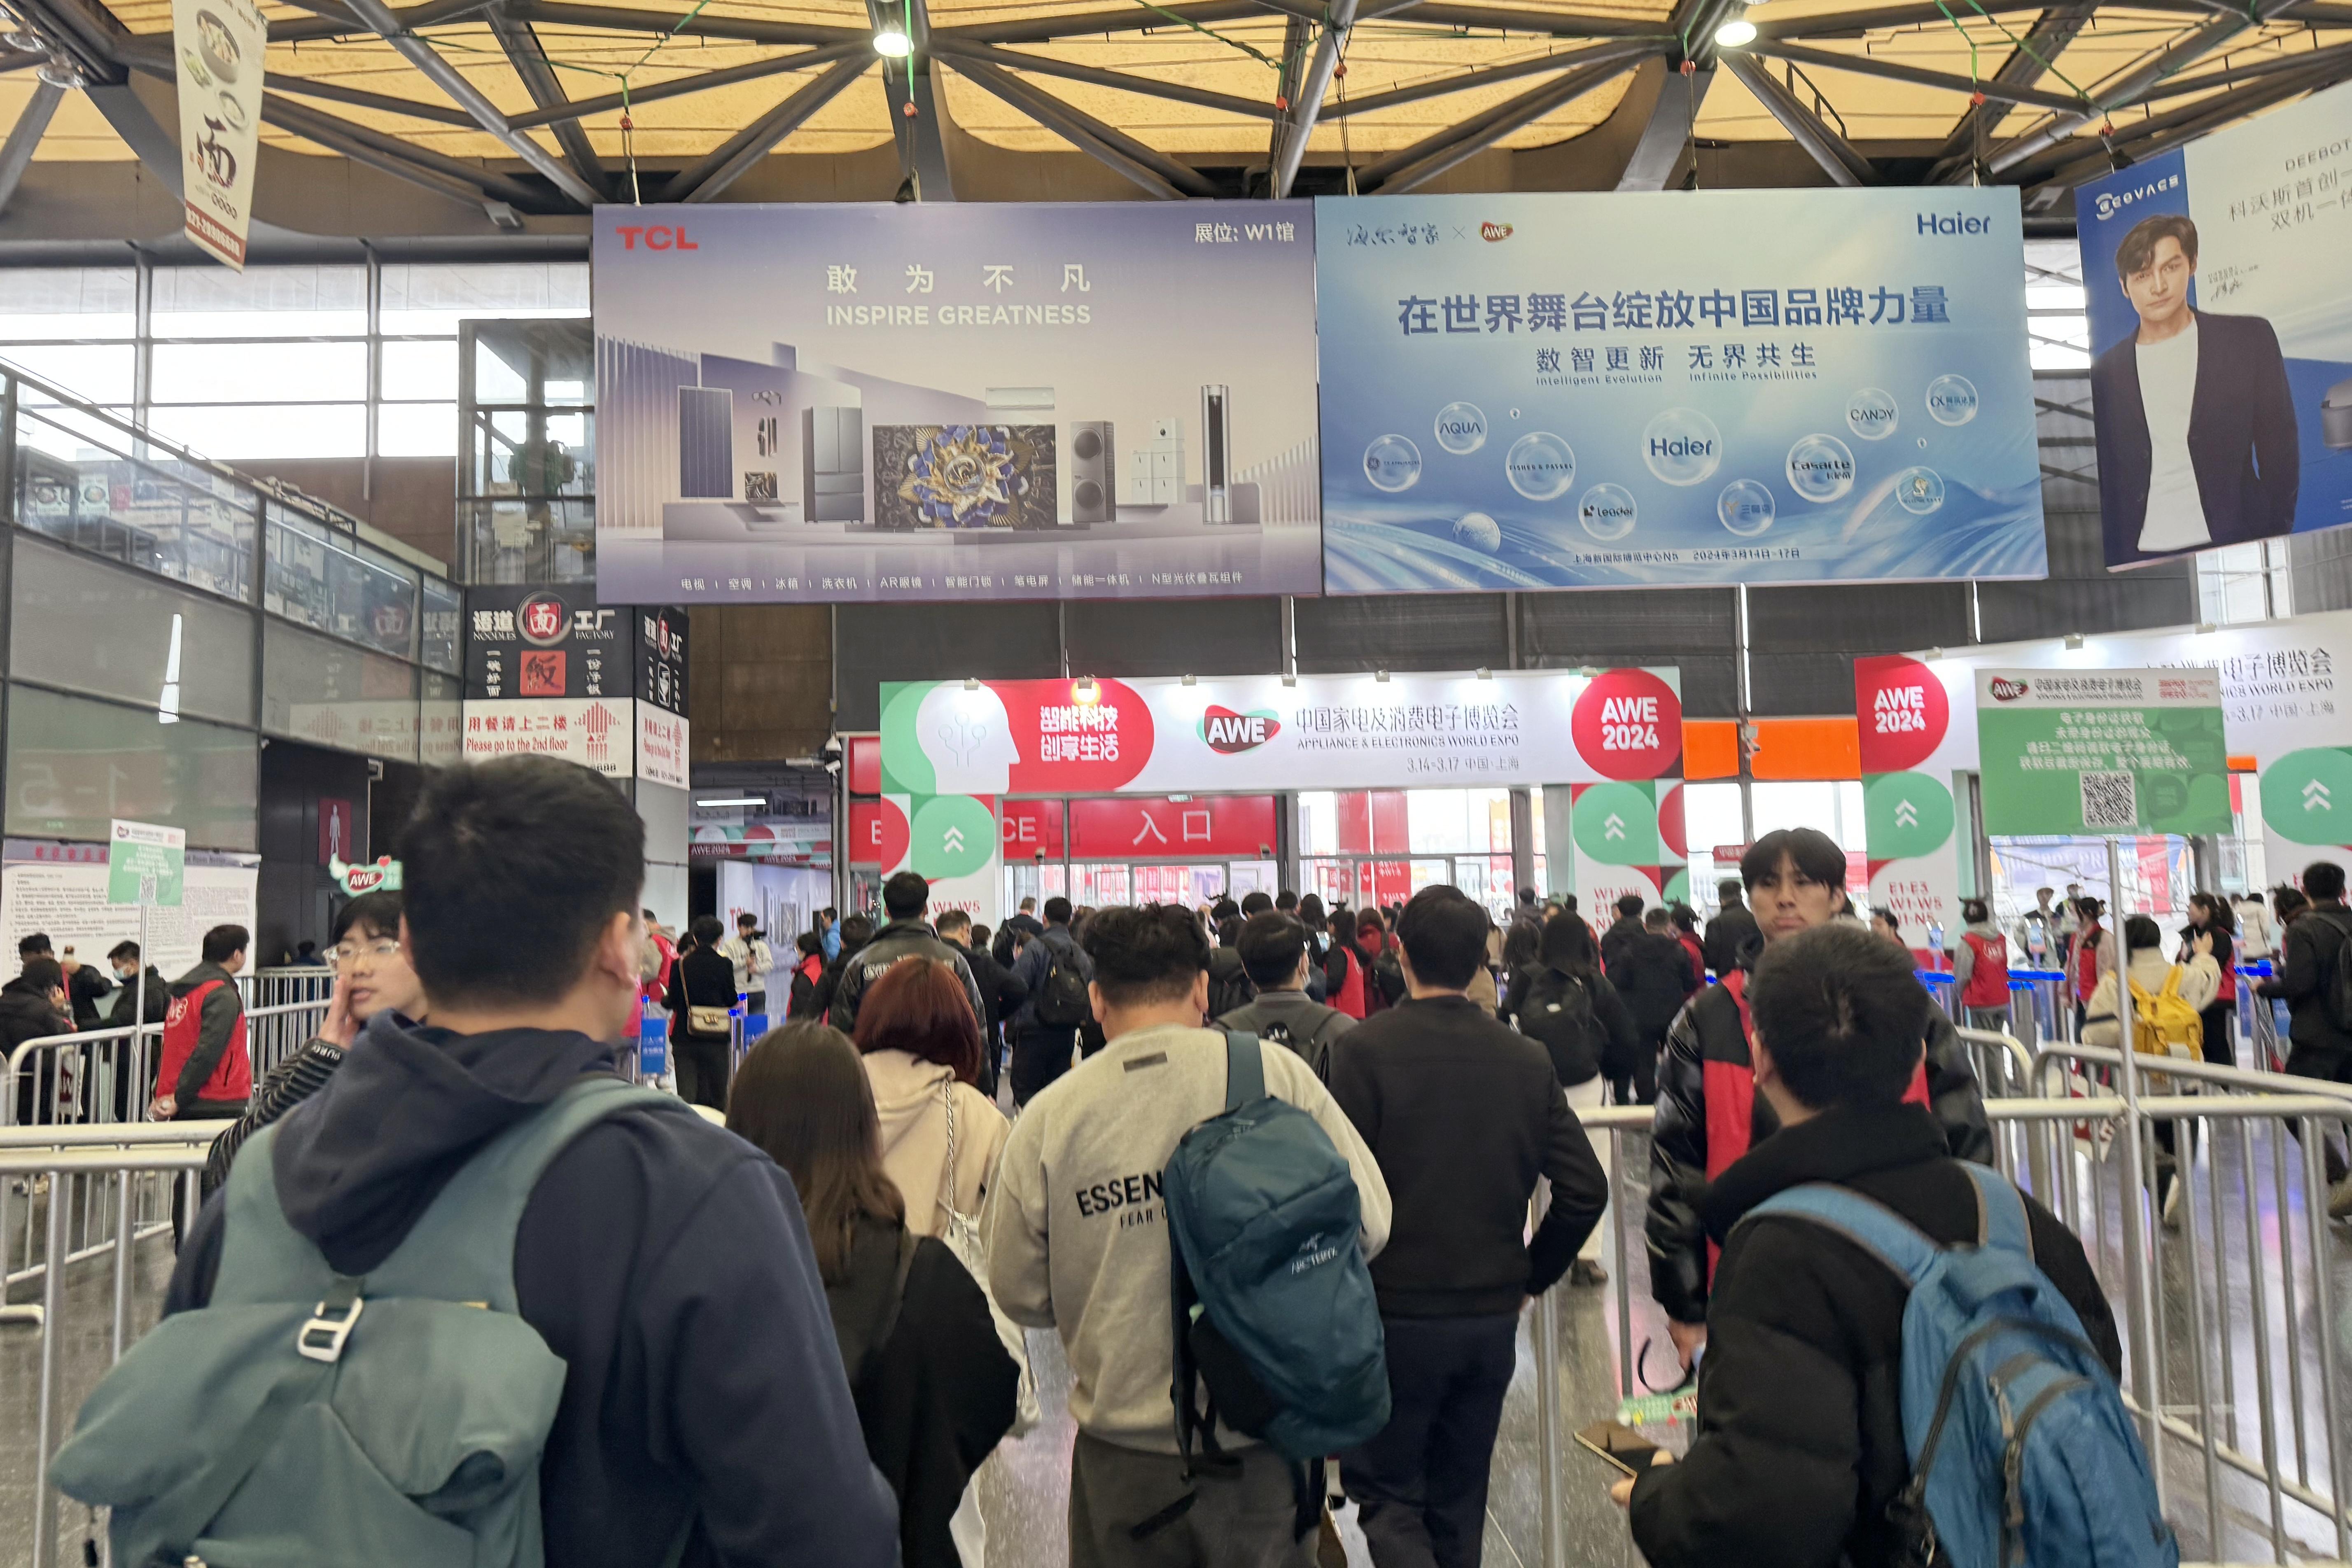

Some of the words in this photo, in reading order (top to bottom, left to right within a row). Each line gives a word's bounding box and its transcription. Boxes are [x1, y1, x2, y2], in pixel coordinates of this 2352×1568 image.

[2285, 138, 2351, 172] DEEBOT
[1245, 222, 1295, 243] W1馆
[1483, 226, 1508, 238] AWE
[1916, 210, 1991, 236] Haier
[616, 225, 699, 251] TCL
[826, 264, 1091, 294] 敢为不凡
[827, 305, 929, 325] INSPIRE
[938, 305, 1091, 324] GREATNESS
[1398, 285, 1951, 336] 在世界舞台绽放中国品牌力量
[1536, 345, 1665, 373] 数智更新
[1688, 342, 1816, 369] 无界共生
[1536, 375, 1601, 386] Intelligent
[1605, 373, 1662, 384] Evolution
[1690, 371, 1736, 383] Infinite
[1743, 370, 1817, 381] Possibilities
[1850, 408, 1894, 422] CANDY
[1440, 422, 1482, 434] AQUA
[1650, 437, 1713, 457] Haier
[1791, 460, 1851, 472] Casarte
[681, 578, 705, 591] 电视
[728, 578, 751, 590] 空调
[775, 577, 798, 590] 冰箱
[822, 576, 857, 590] 洗衣机
[880, 576, 923, 589] AR眼镜
[945, 575, 992, 588] 智能门锁
[574, 609, 616, 631] 工厂
[576, 630, 614, 640] FACTORY
[1874, 685, 1926, 711] AWE
[2248, 681, 2295, 697] WORLD
[2298, 678, 2333, 693] EXPO
[1040, 705, 1118, 733] 智能科技
[1296, 702, 1519, 733] 中国家电及消费电子博览会
[1599, 696, 1659, 724] AWE
[468, 714, 567, 733] 用餐请上二楼
[1207, 716, 1267, 744] AWE
[1875, 710, 1927, 733] 2024
[466, 737, 492, 752] Please
[494, 740, 504, 755] go
[506, 737, 515, 751] to
[517, 736, 530, 752] the
[532, 736, 548, 751] 2nd
[549, 735, 568, 751] floor
[1041, 734, 1119, 762] 创享生活
[1297, 736, 1358, 750] APPLIANCE
[1362, 736, 1369, 749] &
[1372, 735, 1446, 749] ELECTRONICS
[1447, 734, 1487, 747] WORLD
[1491, 733, 1519, 747] EXPO
[1602, 724, 1661, 751] 2024
[1132, 809, 1211, 846] 入口
[350, 872, 376, 887] AWE
[1076, 1169, 1164, 1218] ESSEN
